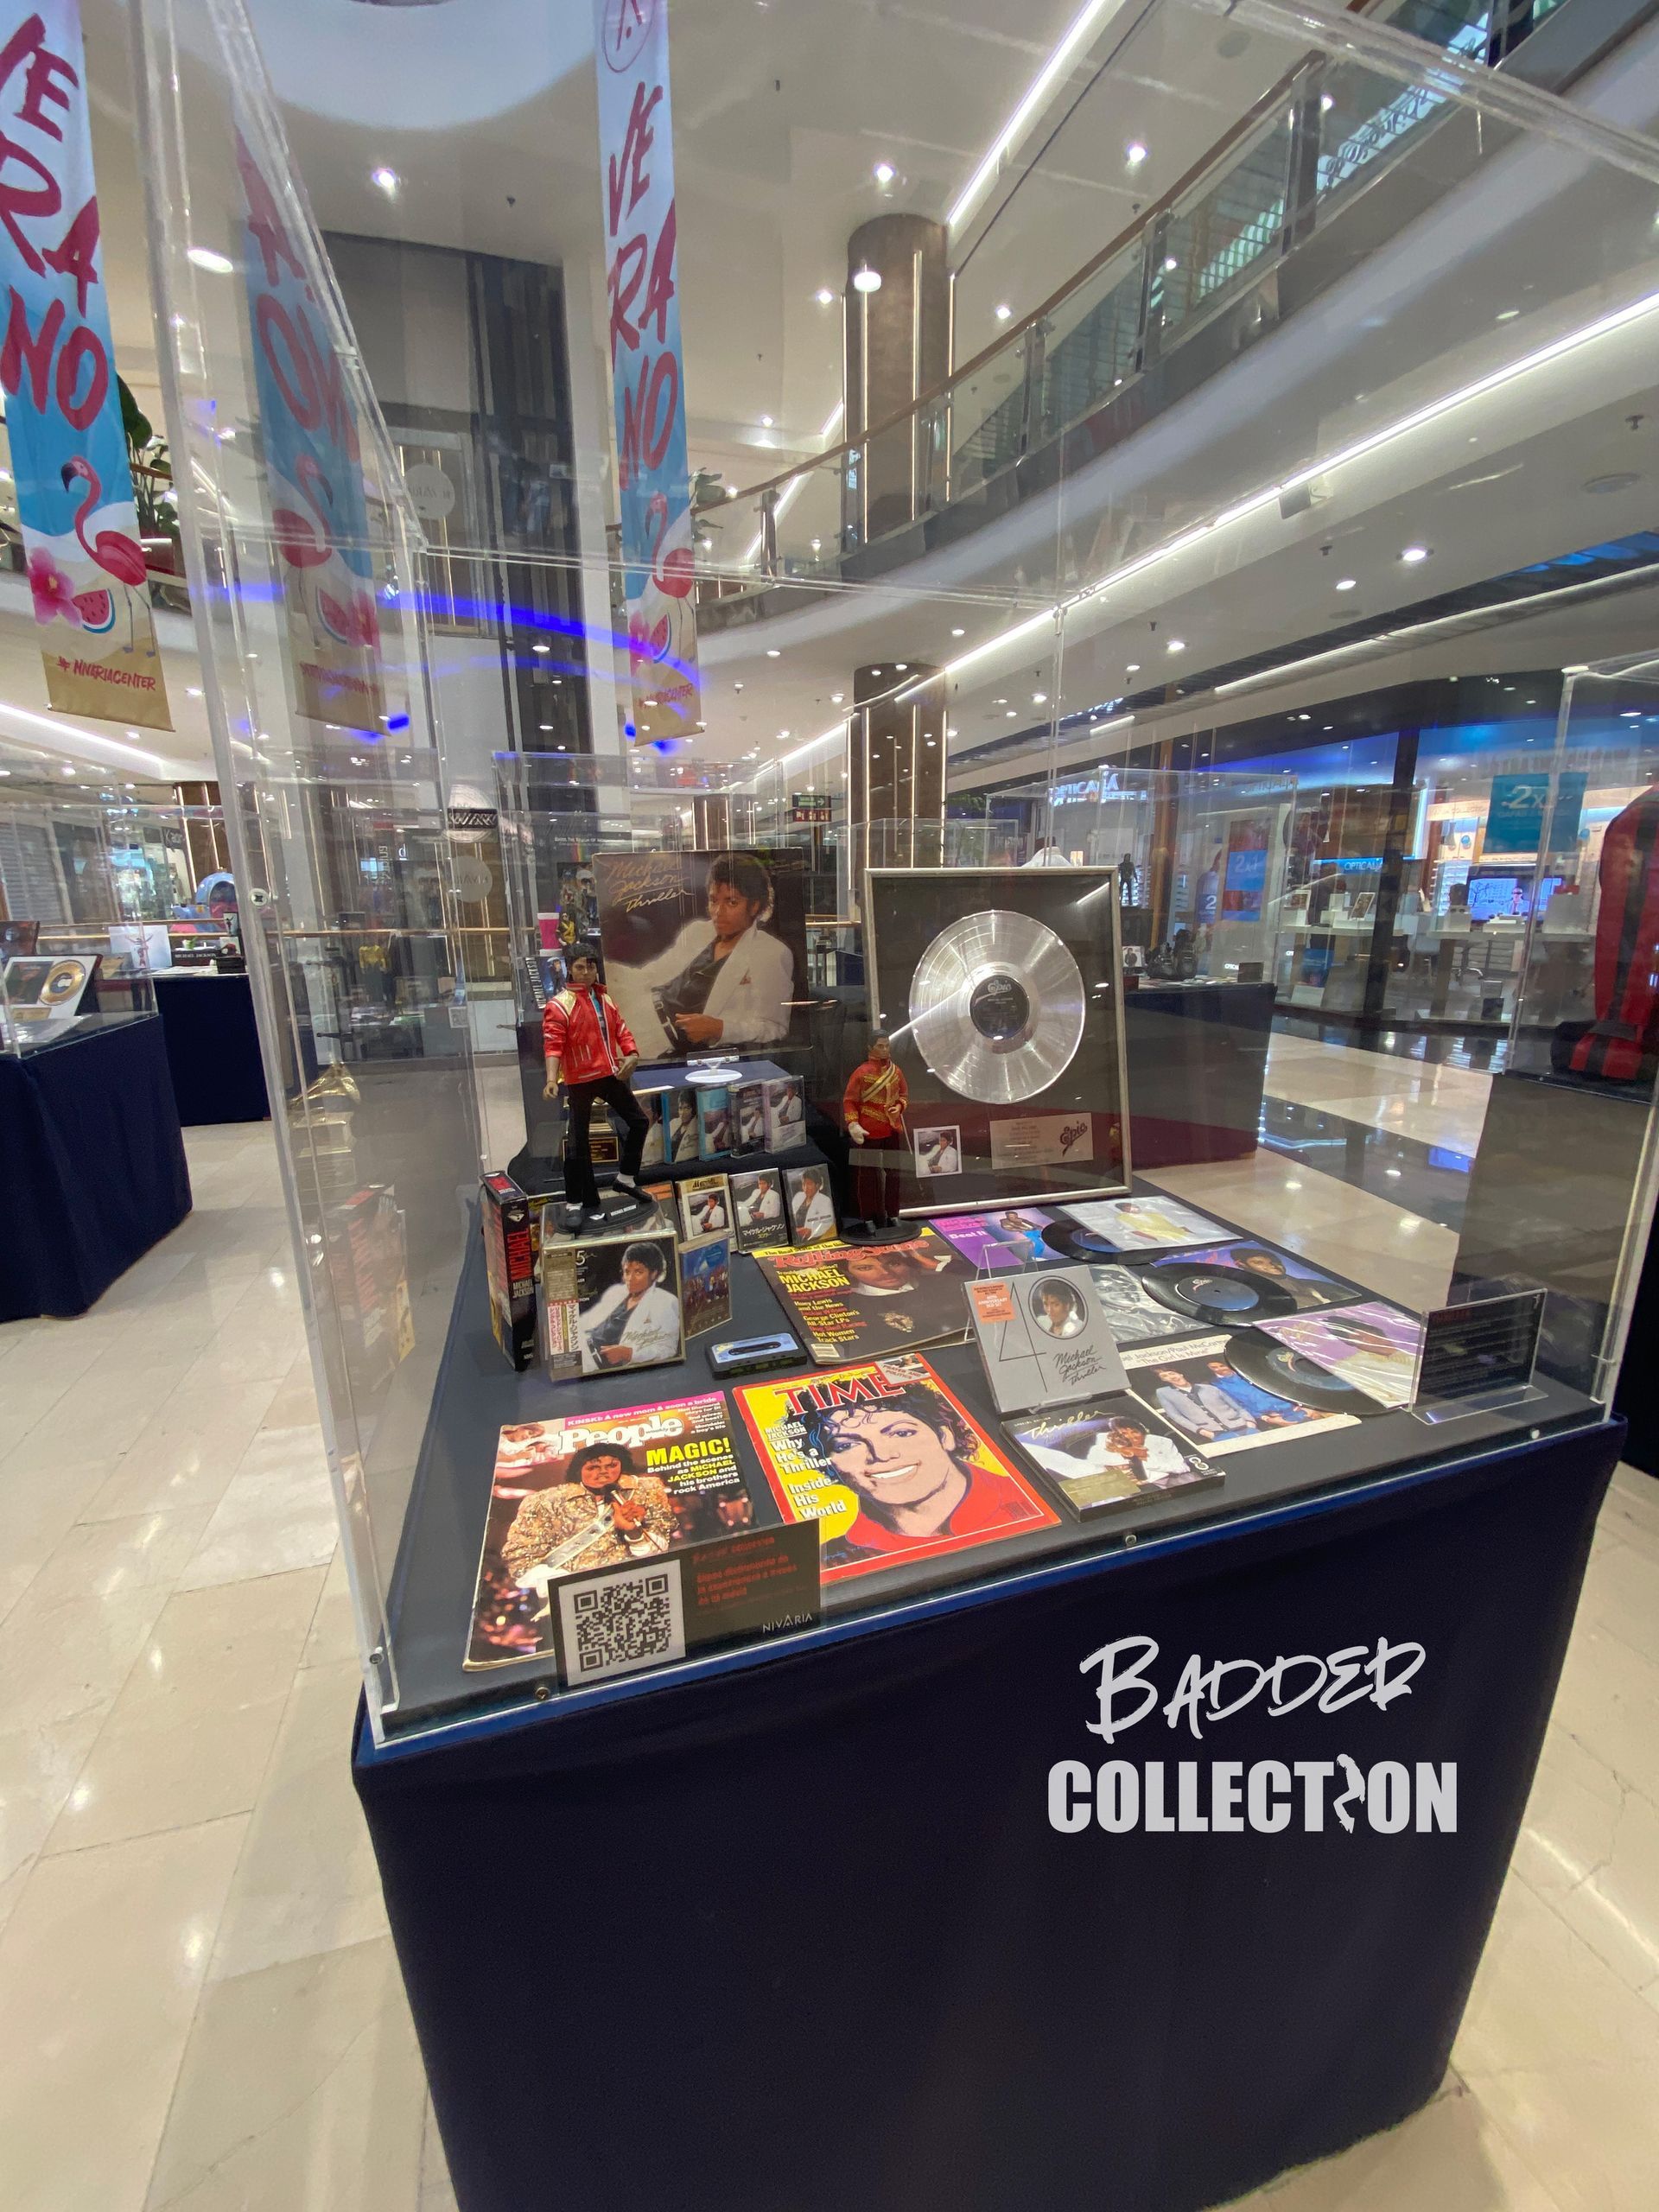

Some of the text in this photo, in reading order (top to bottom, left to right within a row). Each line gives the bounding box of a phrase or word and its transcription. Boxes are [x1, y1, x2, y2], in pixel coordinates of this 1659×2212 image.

[608, 80, 664, 238] VE
[608, 197, 677, 372] RA
[0, 288, 110, 432] NO
[619, 352, 680, 492] NO
[608, 874, 691, 906] Jackson
[622, 888, 696, 913] Thriller
[1059, 1120, 1088, 1157] Epic
[779, 1267, 846, 1285] MICHAEL
[786, 1276, 851, 1294] JACKSON
[774, 1372, 906, 1416] TIME
[613, 1411, 632, 1420] new
[632, 1407, 657, 1415] mom
[694, 1397, 717, 1406] bride
[557, 1414, 683, 1456] People
[765, 1421, 804, 1435] MICHAEL
[768, 1427, 808, 1441] JACKSON
[646, 1437, 732, 1466] MAGIC!
[770, 1438, 803, 1452] Why
[647, 1460, 682, 1474] Behind
[700, 1453, 734, 1464] scenes
[690, 1459, 736, 1472] MICHAEL
[776, 1447, 819, 1465] He's a
[779, 1457, 832, 1475] Thriller
[667, 1465, 737, 1483] JACKSON and
[696, 1471, 739, 1484] brothers
[673, 1478, 741, 1495] rock America
[788, 1477, 832, 1495] Inside
[793, 1493, 820, 1508] His
[799, 1500, 847, 1520] World
[762, 1612, 813, 1634] NIVARIA
